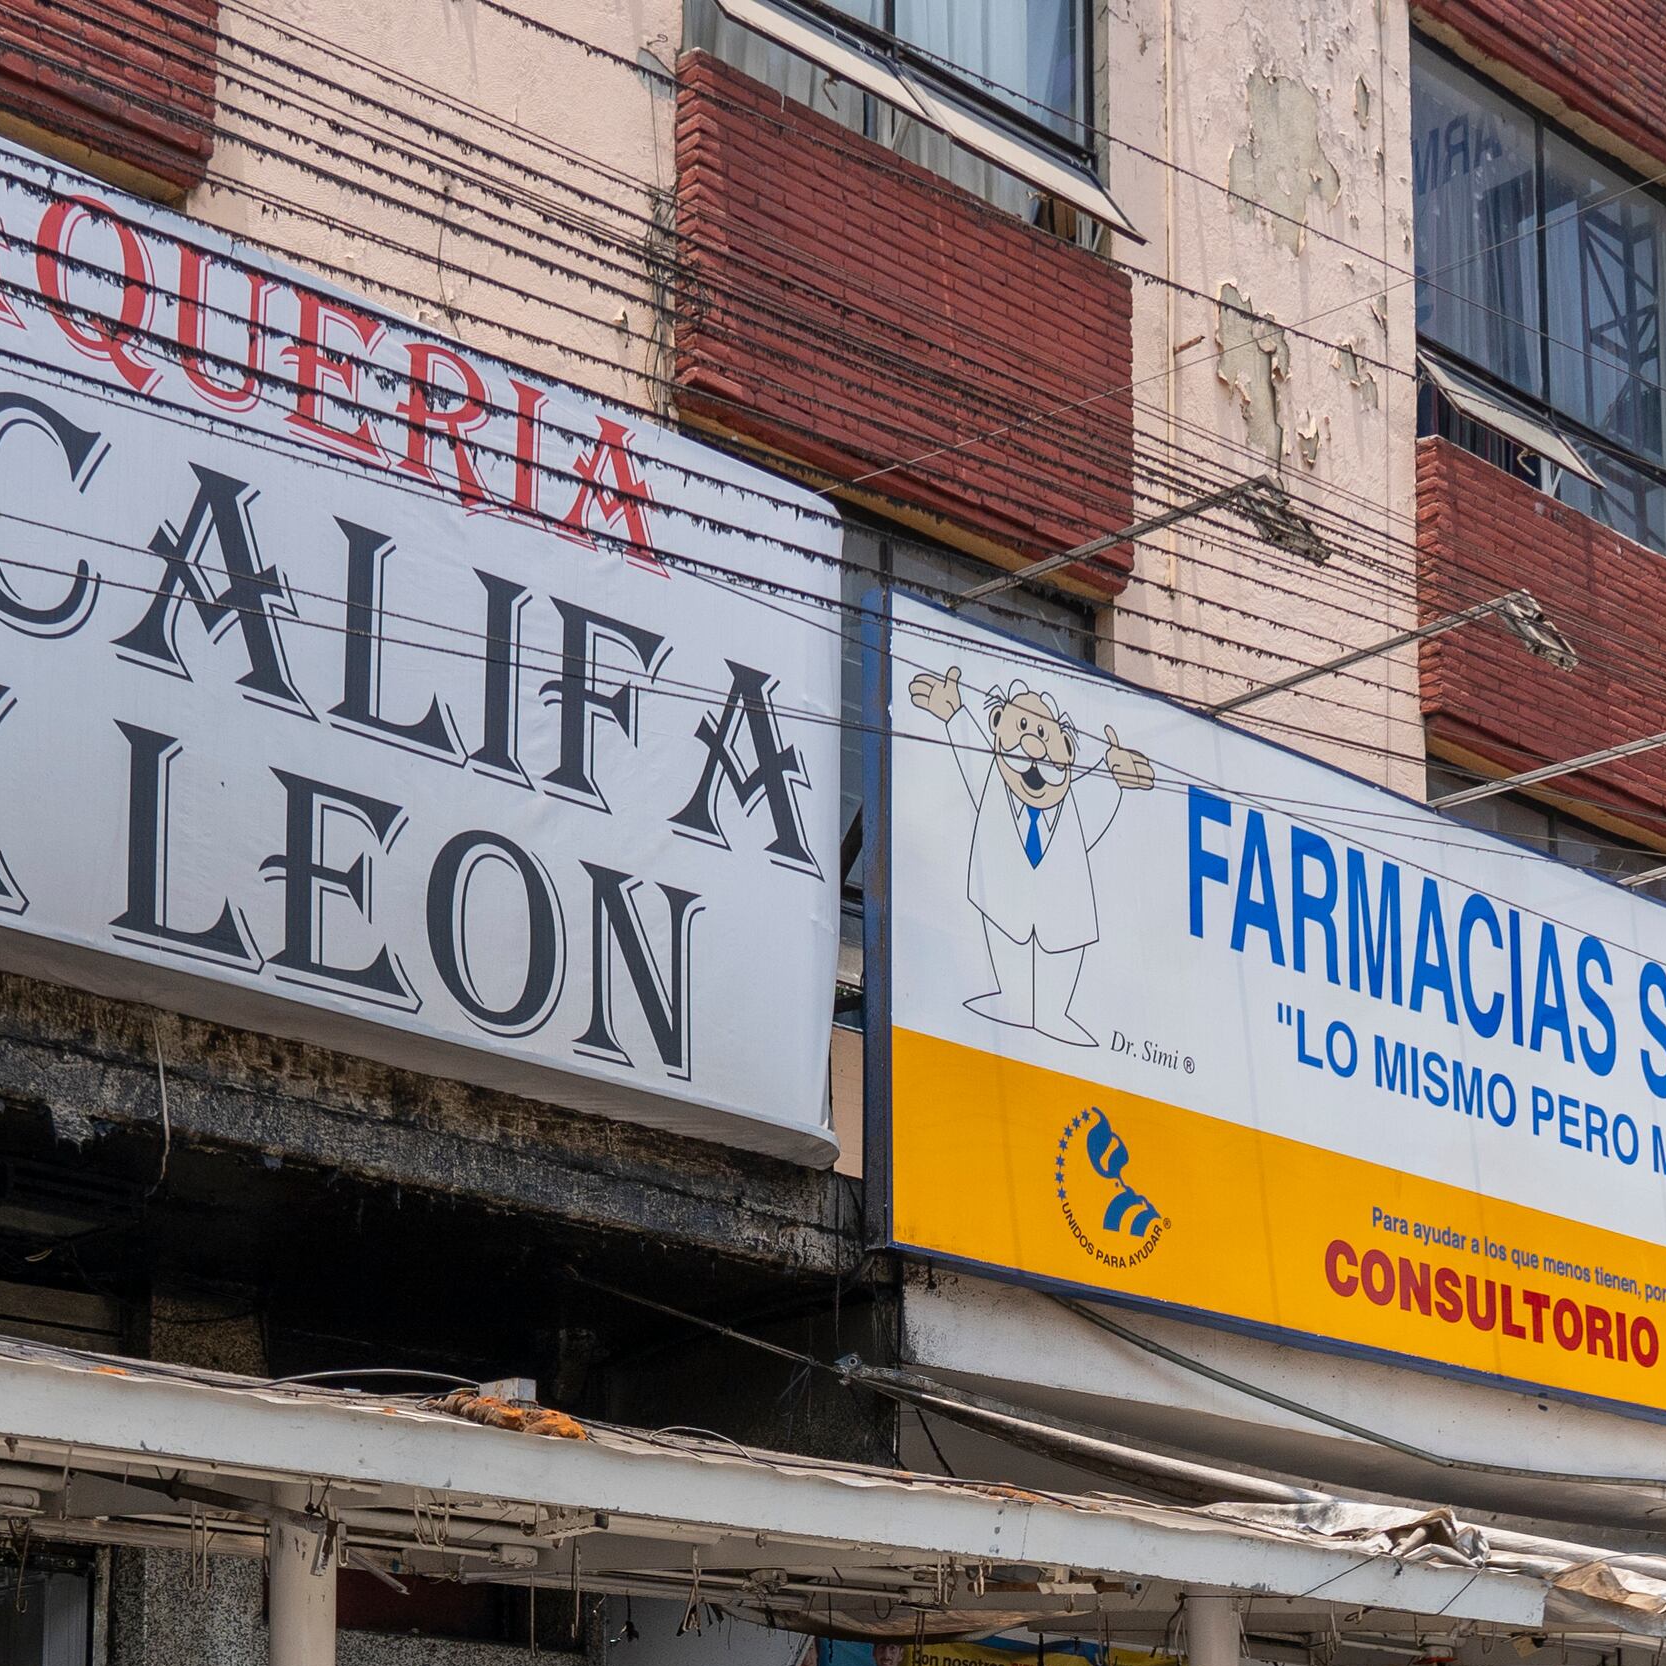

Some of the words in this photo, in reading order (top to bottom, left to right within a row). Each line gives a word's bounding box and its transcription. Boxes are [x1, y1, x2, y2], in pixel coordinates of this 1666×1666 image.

[111, 720, 704, 1082] LEON
[1187, 784, 1618, 1077] FARMACIAS
[1110, 1031, 1137, 1058] Dr.
[1141, 1040, 1179, 1071] Simi
[1277, 1002, 1358, 1078] "LO
[1374, 1034, 1517, 1128] MISMO
[1532, 1085, 1639, 1166] PERO
[1061, 1200, 1095, 1257] UNIDOS
[1095, 1250, 1127, 1269] PARA
[1128, 1224, 1164, 1268] AYUDAR
[1372, 1206, 1409, 1236] Para
[1413, 1215, 1467, 1254] ayudar
[1470, 1239, 1480, 1256] a
[1484, 1235, 1507, 1262] los
[1511, 1247, 1540, 1271] que
[1543, 1255, 1592, 1284] menos
[1594, 1266, 1643, 1301] tienen,
[1324, 1238, 1660, 1369] CONSULTORIO
